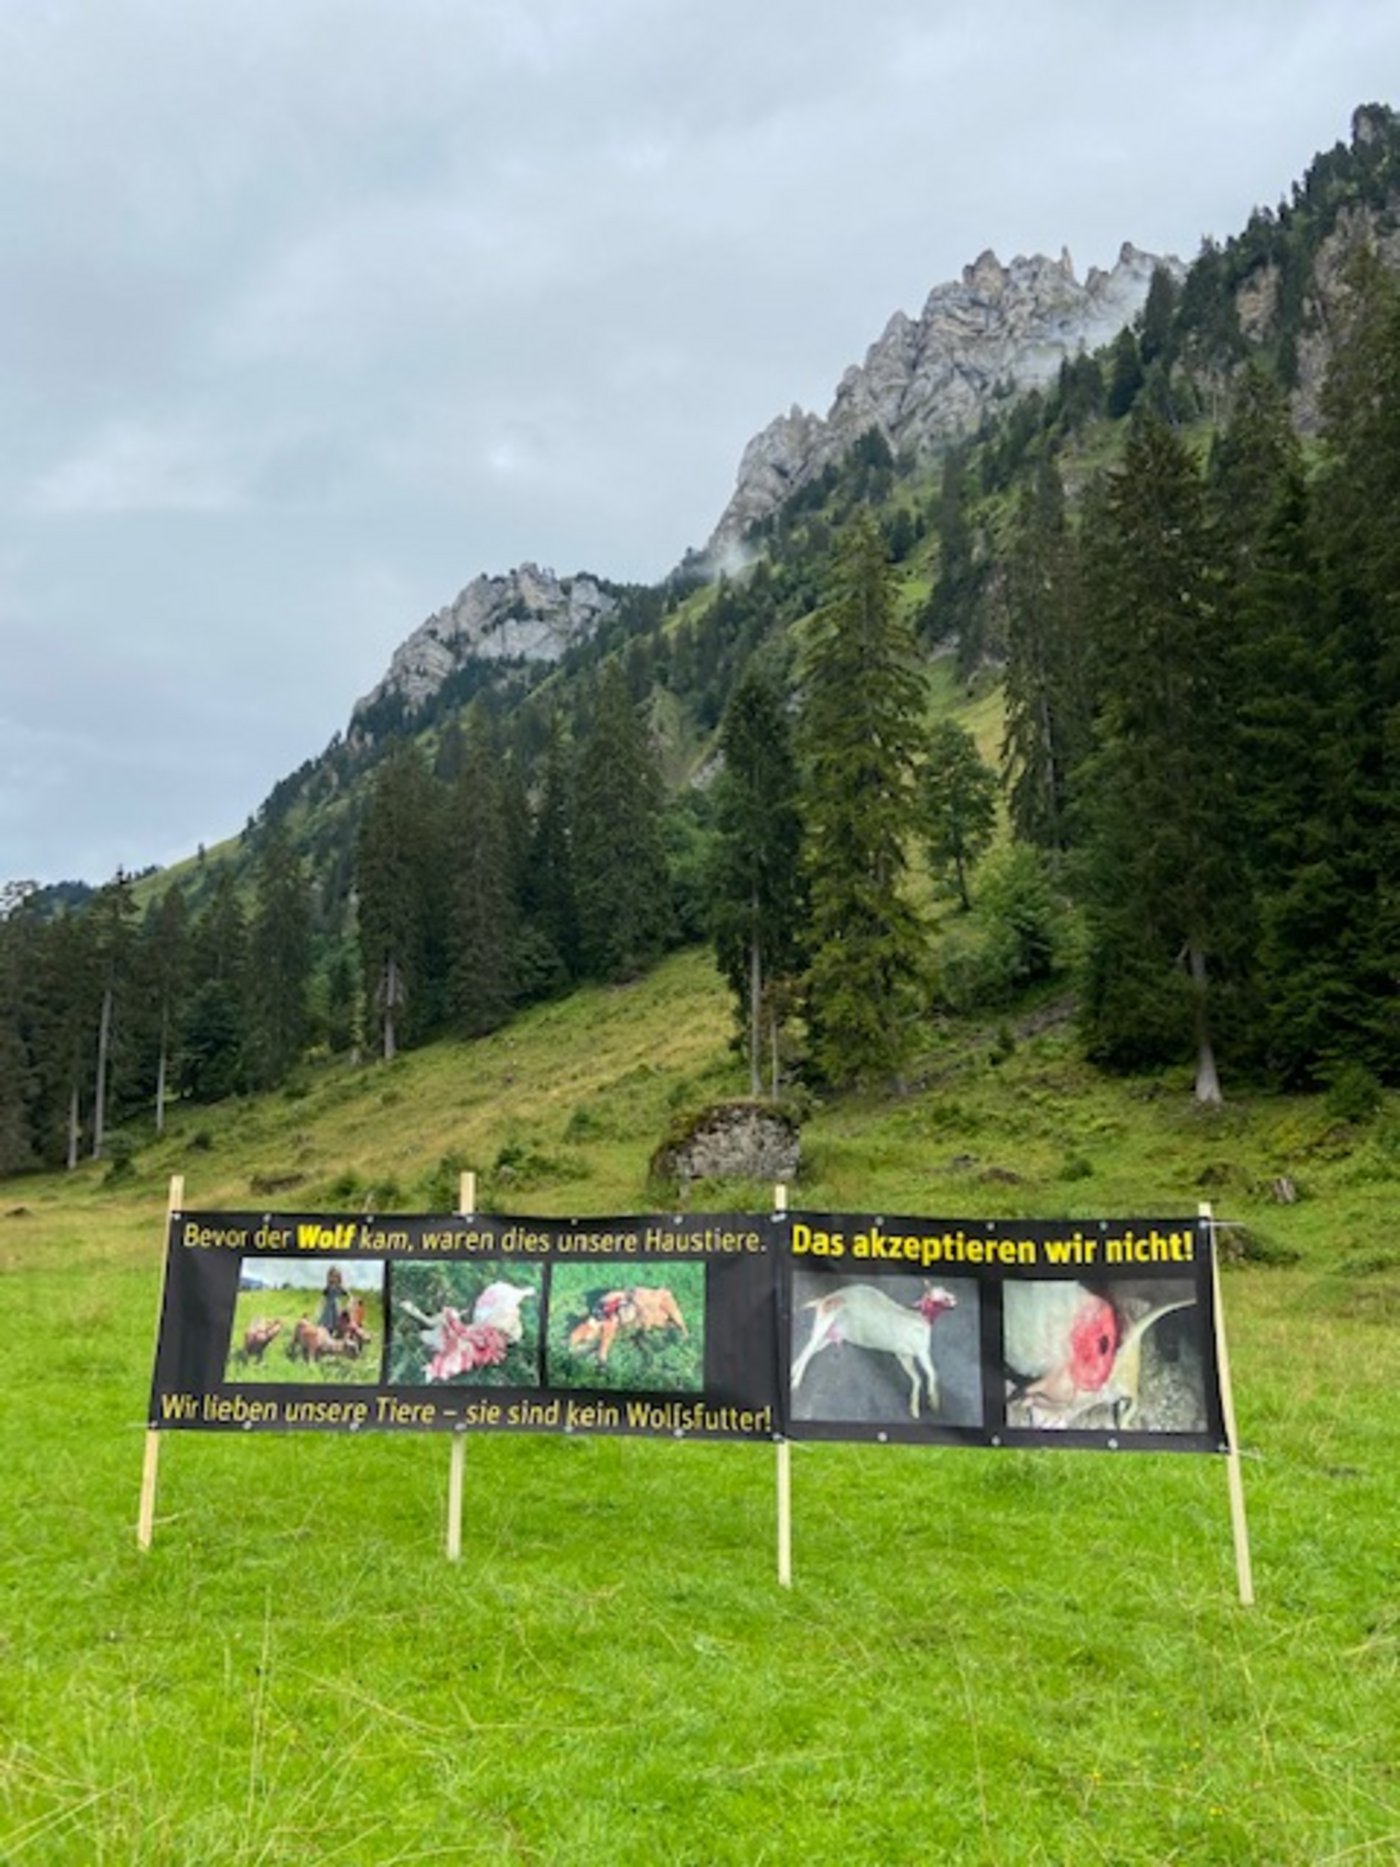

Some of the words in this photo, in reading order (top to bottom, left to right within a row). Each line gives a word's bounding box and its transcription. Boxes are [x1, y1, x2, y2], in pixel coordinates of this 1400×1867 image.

[183, 1223, 246, 1248] Bevor
[254, 1223, 291, 1248] der
[297, 1224, 356, 1249] Wolf
[359, 1226, 413, 1251] kam,
[422, 1230, 494, 1249] waren
[501, 1226, 550, 1252] dies
[557, 1231, 637, 1251] unsere
[644, 1228, 767, 1252] Haustiere.
[792, 1225, 844, 1256] Das
[853, 1228, 1036, 1266] akzeptieren
[1045, 1233, 1097, 1263] wir
[1105, 1232, 1193, 1262] nicht!
[161, 1394, 198, 1420] Wir
[203, 1394, 278, 1422] lieben
[285, 1401, 367, 1422] unsere
[376, 1397, 436, 1423] Tiere
[466, 1400, 500, 1425] sie
[507, 1400, 559, 1425] sind
[567, 1400, 618, 1428] kein
[626, 1402, 772, 1432] Wolfsfutter!
